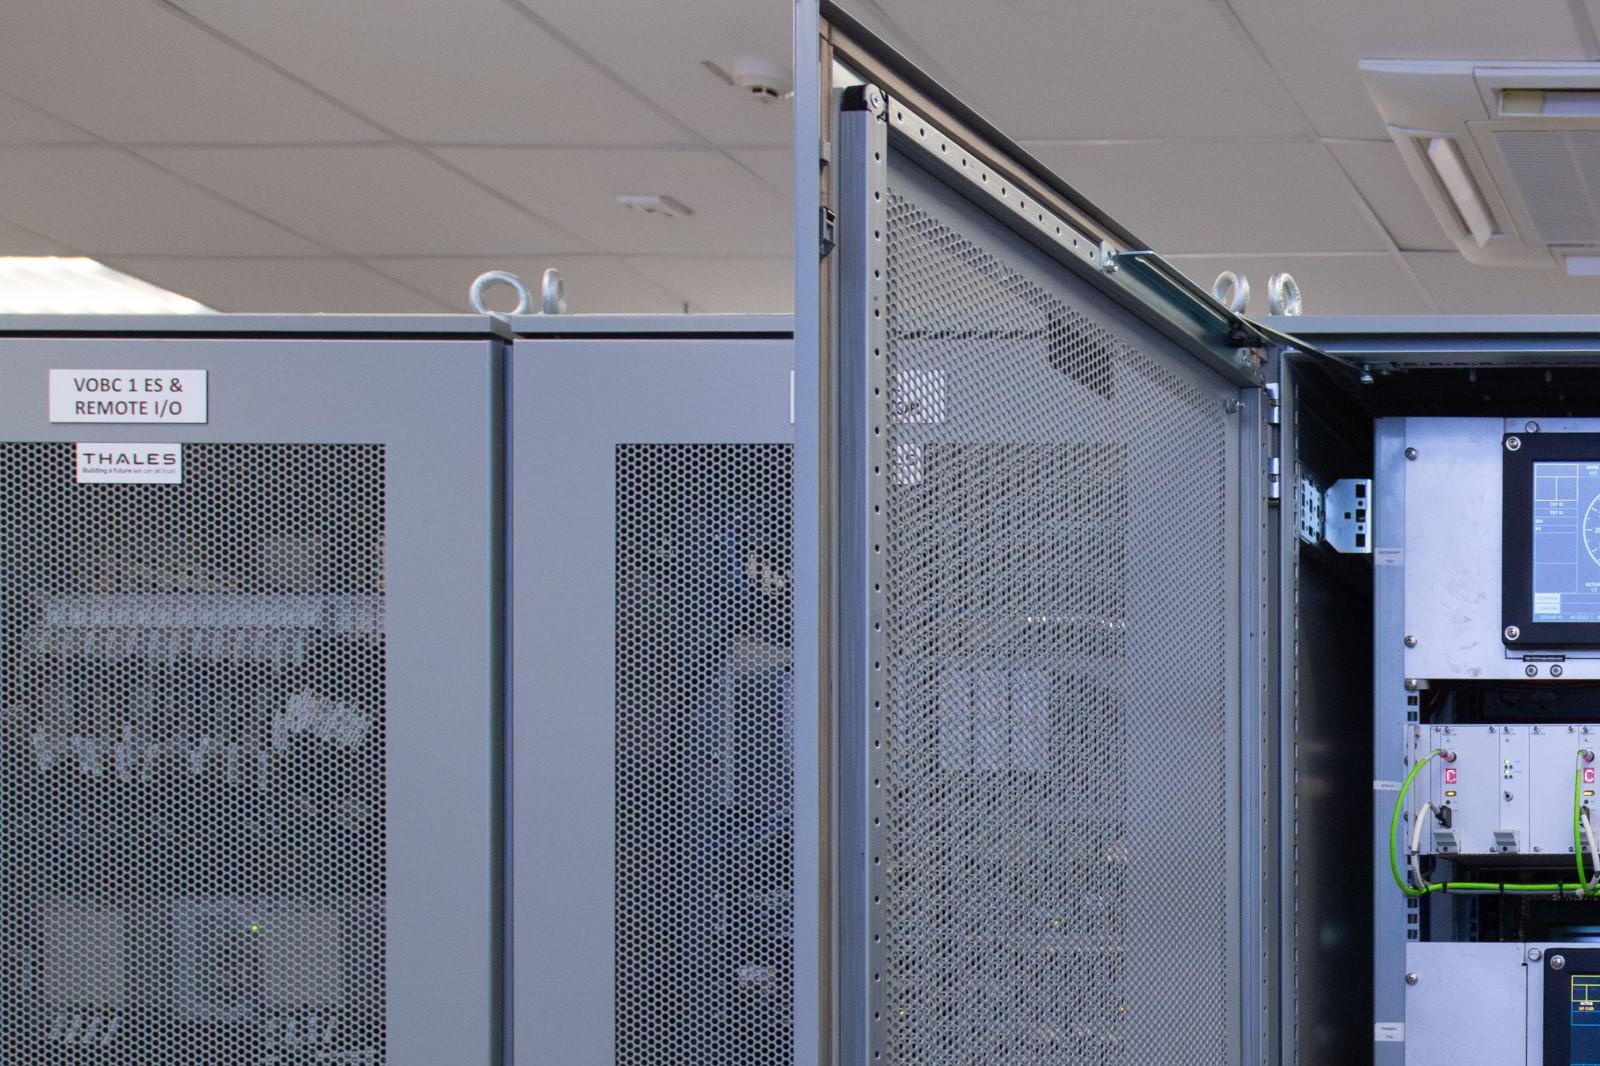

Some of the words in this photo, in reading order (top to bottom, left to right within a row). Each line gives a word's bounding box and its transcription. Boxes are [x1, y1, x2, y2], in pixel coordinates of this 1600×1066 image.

[73, 378, 122, 392] VOBC
[128, 378, 138, 392] 1
[145, 378, 163, 392] ES
[169, 378, 183, 392] &
[75, 401, 148, 415] REMOTE
[155, 400, 182, 418] I/O
[82, 453, 176, 465] THALES
[82, 467, 107, 475] Building
